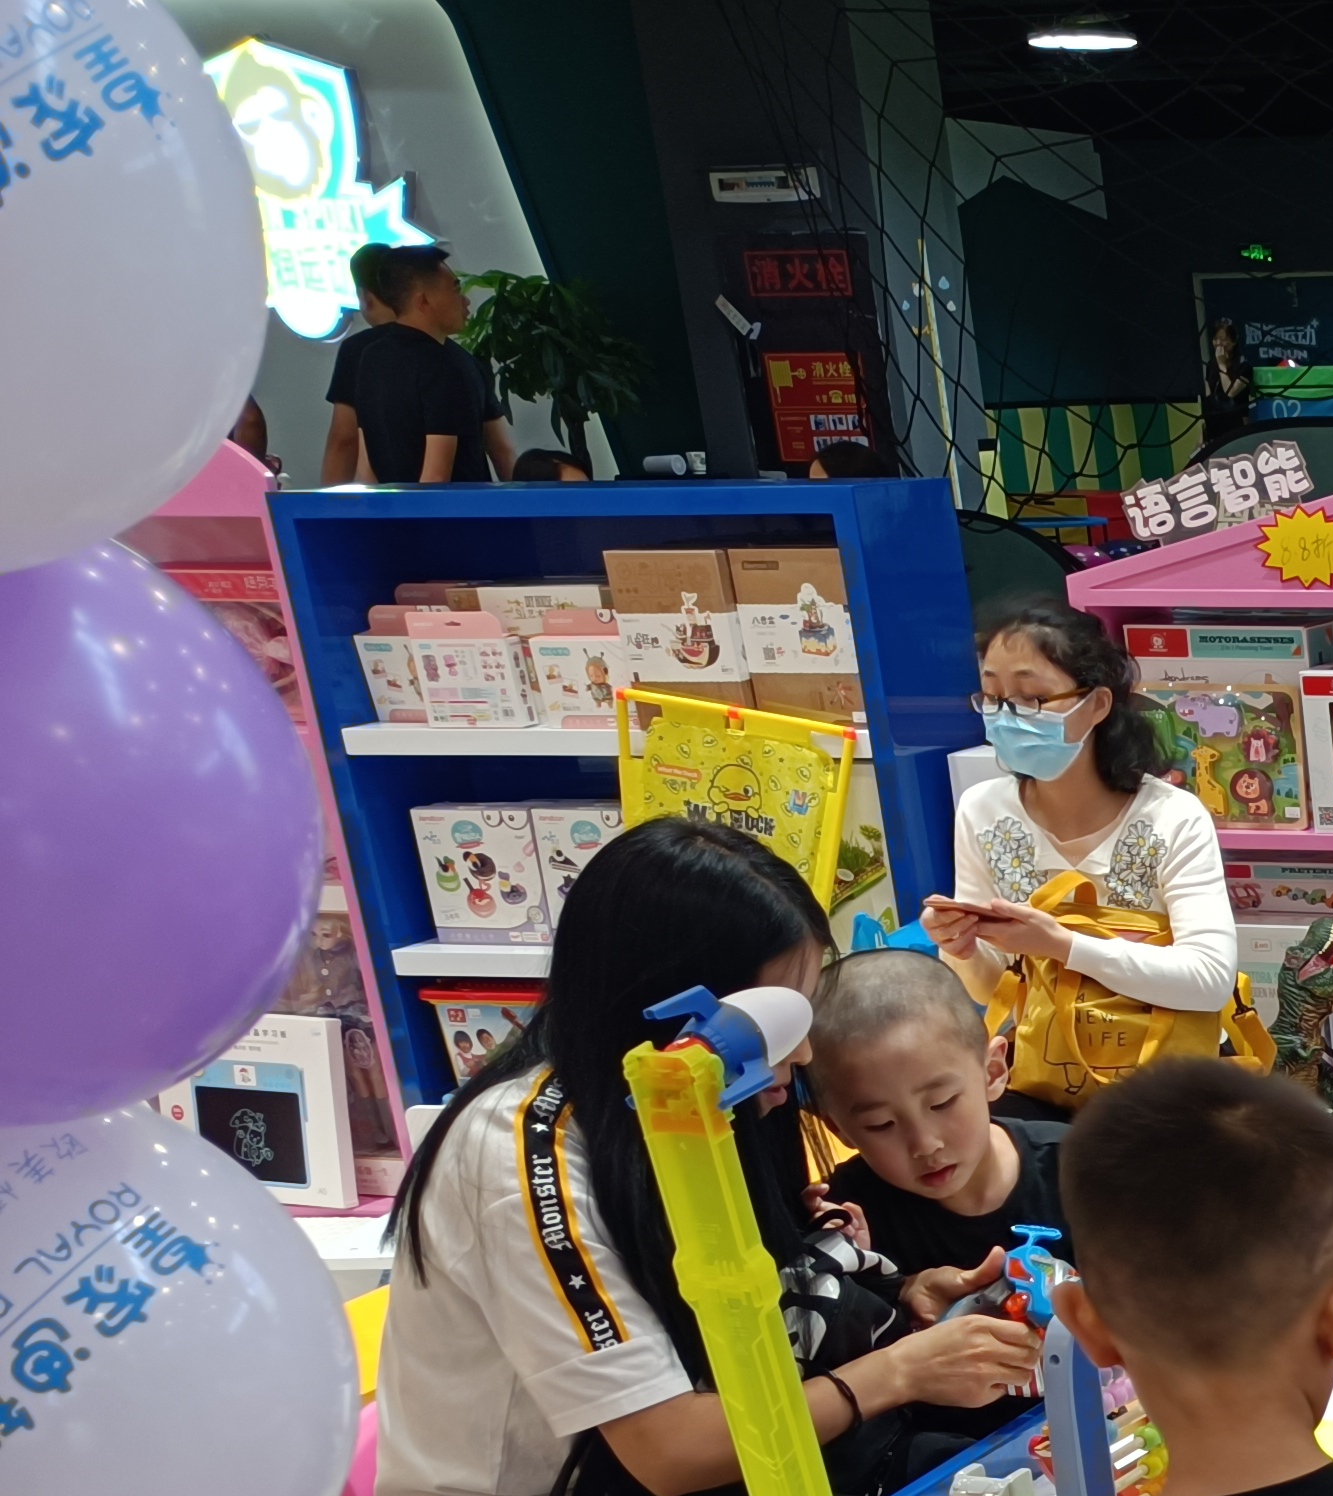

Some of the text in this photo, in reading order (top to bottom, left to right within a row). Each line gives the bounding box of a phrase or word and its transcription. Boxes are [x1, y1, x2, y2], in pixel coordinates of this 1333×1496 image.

[754, 256, 848, 291] 消火栓
[811, 361, 852, 380] 消火栓
[1272, 399, 1301, 419] 02
[1126, 447, 1310, 538] 语言智能
[1087, 1031, 1128, 1048] IFE
[532, 1154, 573, 1251] Monster
[14, 1182, 141, 1275] ROYAL
